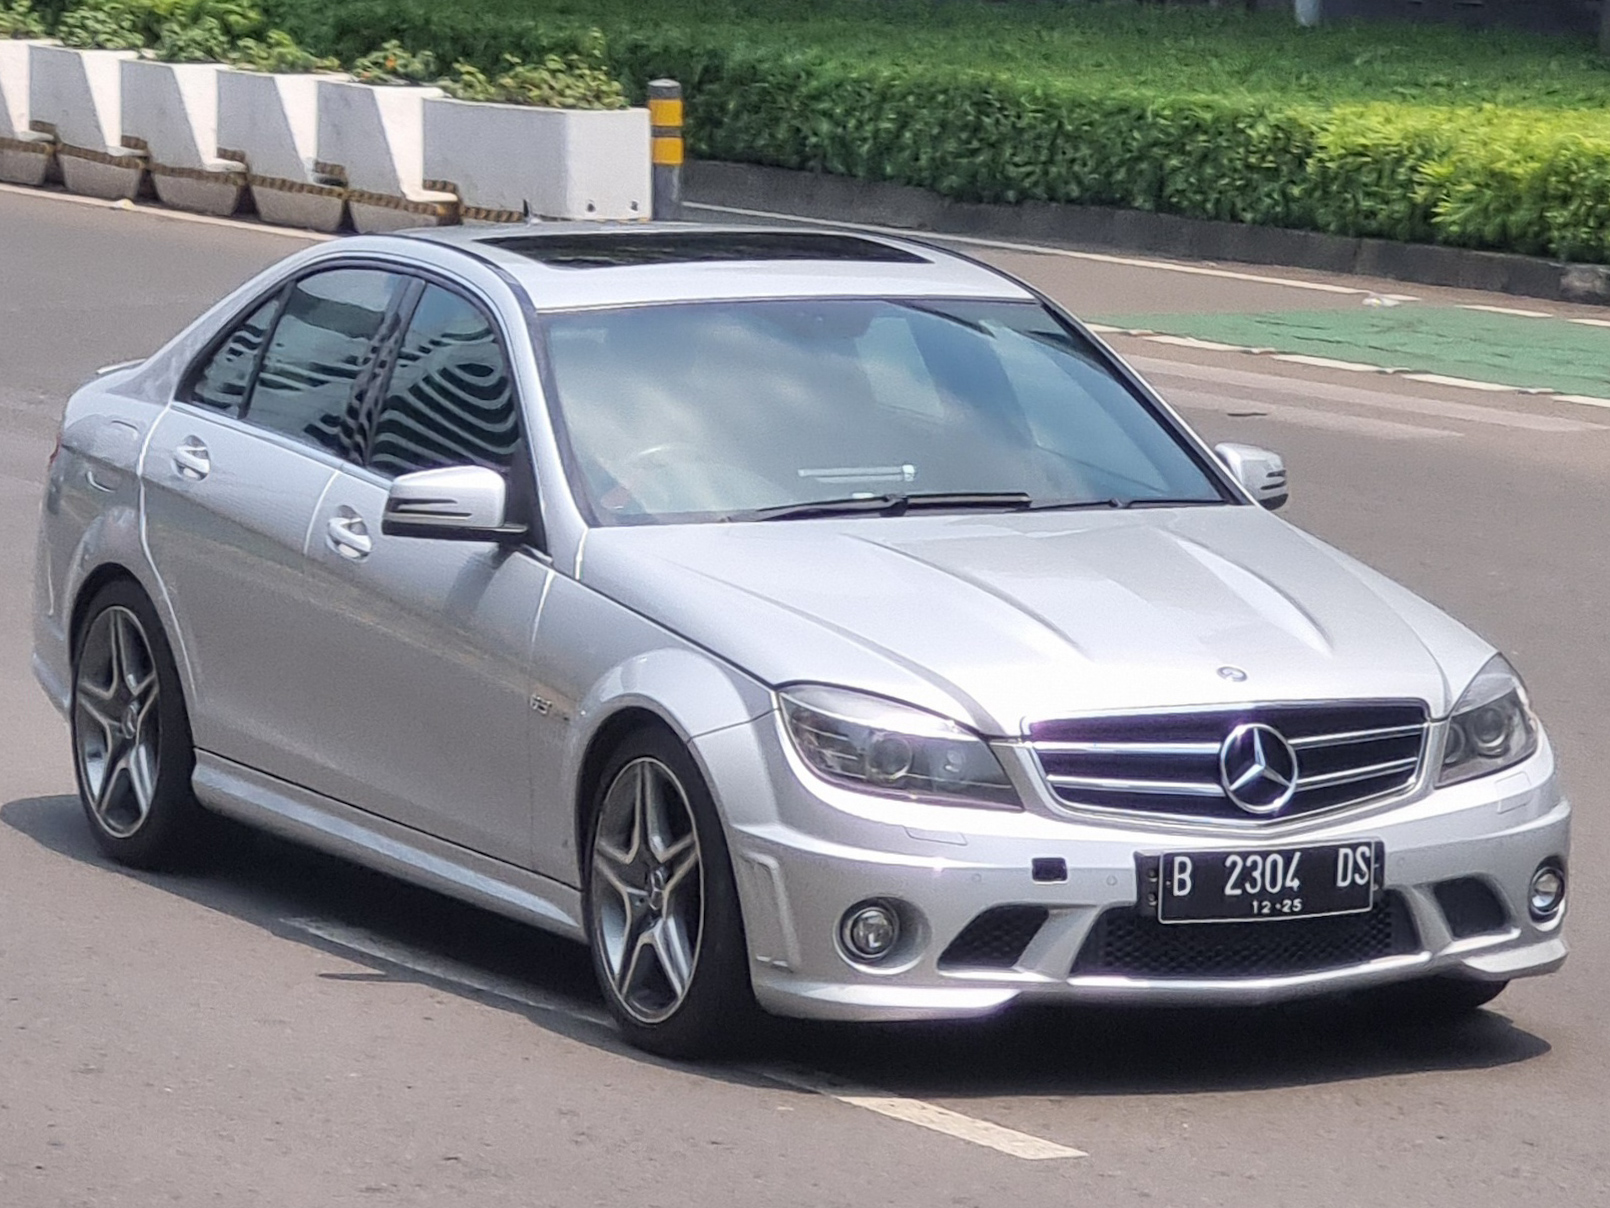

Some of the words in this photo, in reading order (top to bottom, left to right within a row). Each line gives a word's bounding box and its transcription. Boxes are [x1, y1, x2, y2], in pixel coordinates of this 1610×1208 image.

[1173, 856, 1193, 897] B
[1224, 851, 1302, 896] 2304
[1336, 845, 1371, 888] DS
